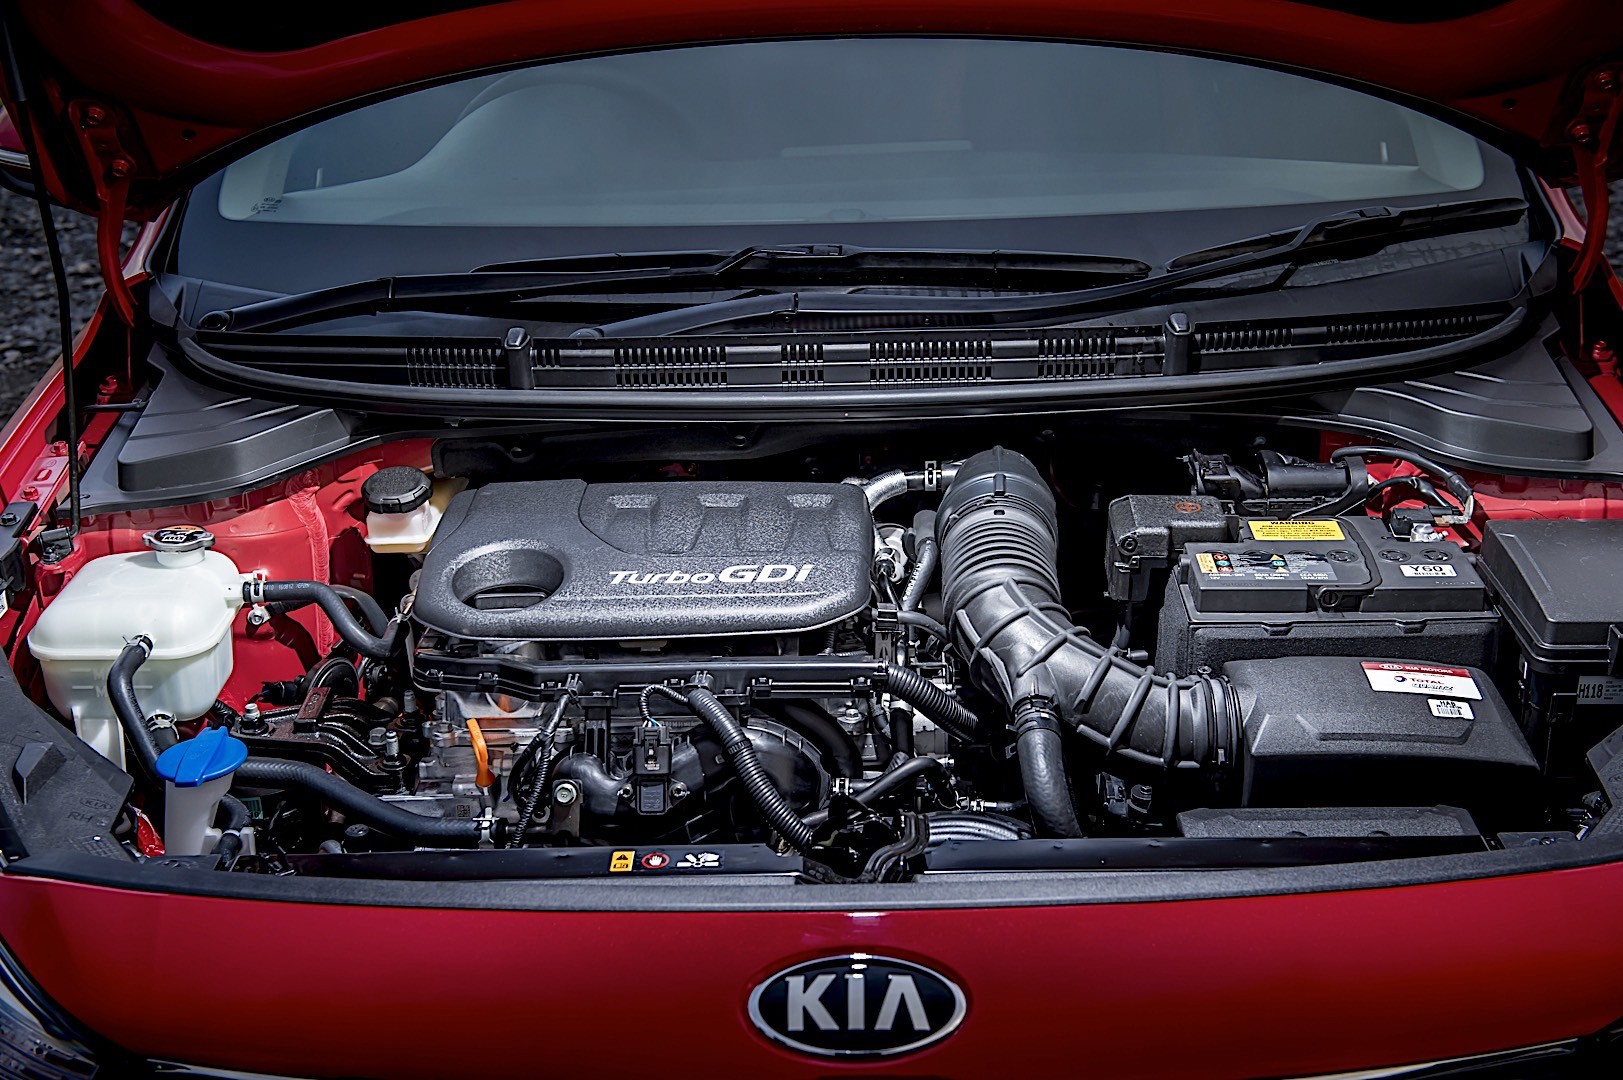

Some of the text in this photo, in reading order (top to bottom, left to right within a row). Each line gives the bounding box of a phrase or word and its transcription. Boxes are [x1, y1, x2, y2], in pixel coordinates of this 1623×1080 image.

[1409, 677, 1445, 685] TOTAL
[1577, 683, 1604, 699] H118
[785, 973, 931, 1031] KIA
